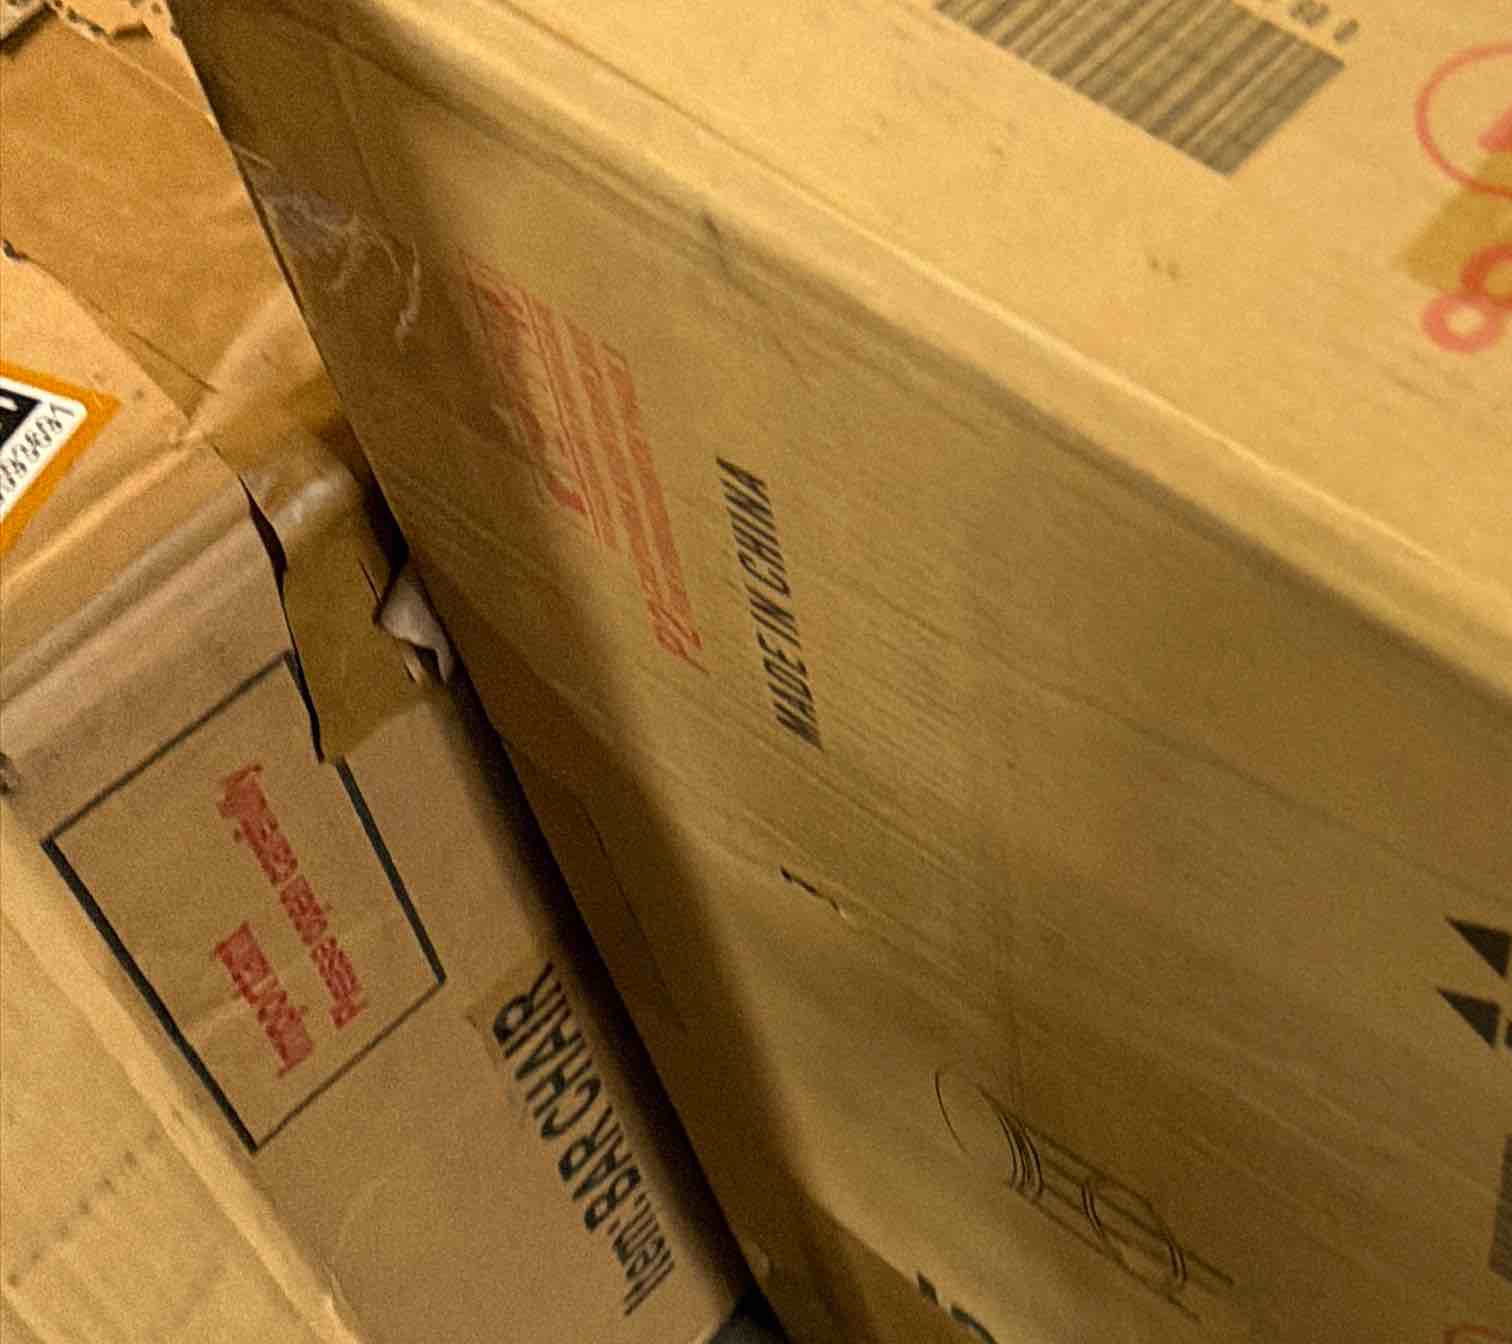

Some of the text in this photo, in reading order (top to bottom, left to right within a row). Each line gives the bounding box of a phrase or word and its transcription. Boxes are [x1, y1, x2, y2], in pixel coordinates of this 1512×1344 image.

[715, 456, 825, 752] MADE IN CHINA
[493, 960, 602, 1140] CHAIR
[557, 1104, 642, 1234] BAR
